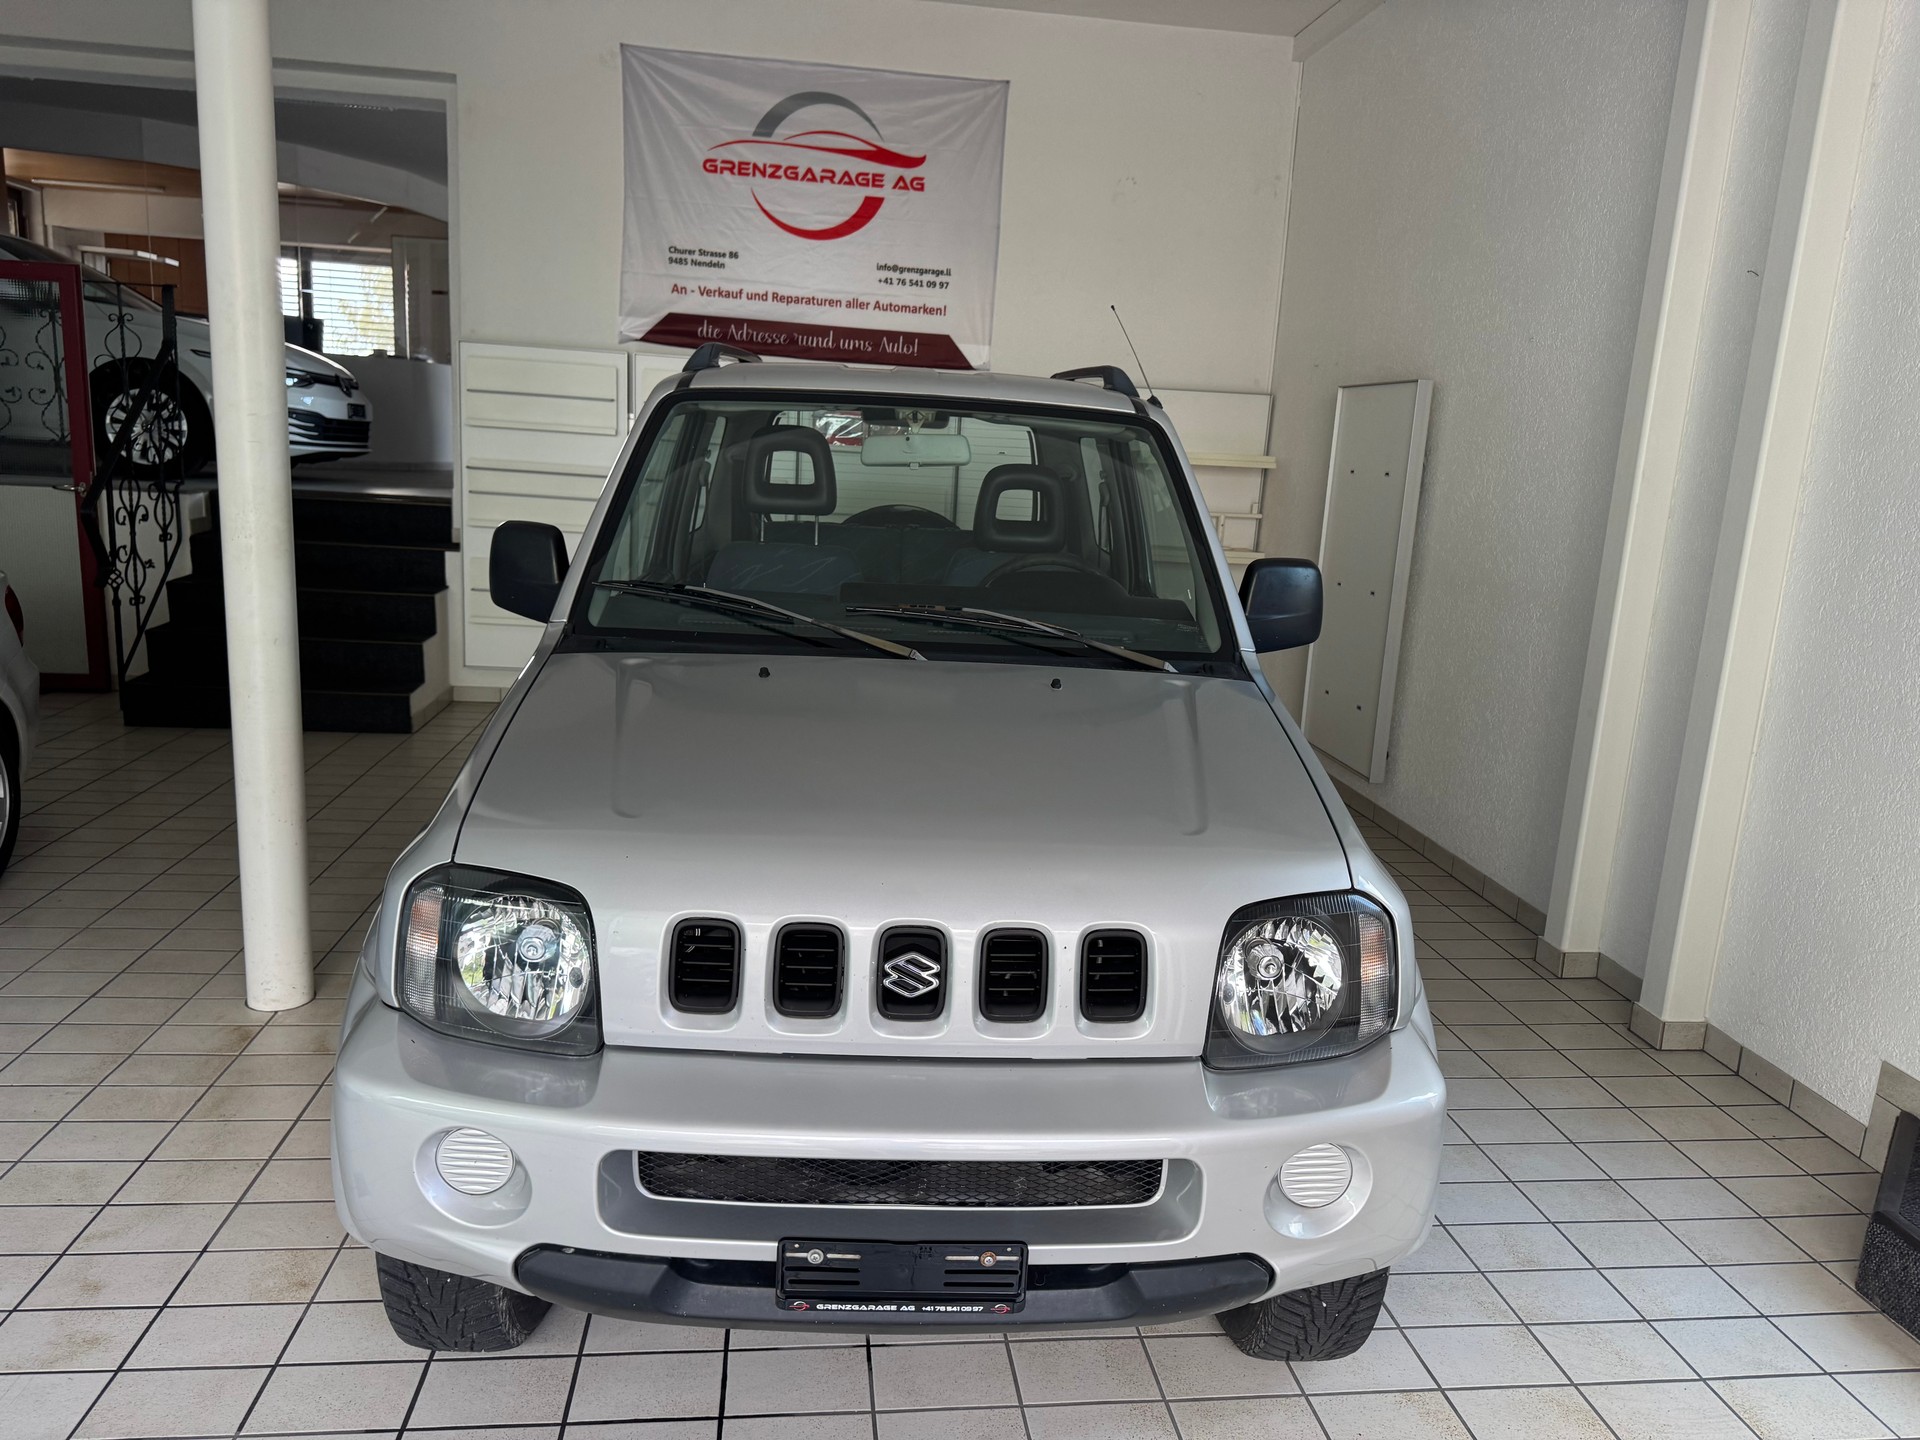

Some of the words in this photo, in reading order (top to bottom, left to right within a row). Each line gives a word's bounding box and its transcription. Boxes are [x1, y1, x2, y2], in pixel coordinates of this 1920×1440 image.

[702, 158, 885, 189] GRENZGARAGE
[891, 174, 925, 193] AG
[668, 246, 696, 257] Churer
[698, 248, 727, 259] Strasse
[728, 251, 739, 260] 86
[668, 257, 688, 266] 9485
[690, 258, 726, 270] Nendeln
[876, 262, 952, 278] info@grenzgarage.li
[878, 277, 894, 286] +41
[896, 278, 907, 287] 76
[908, 279, 924, 289] 541
[926, 280, 937, 289] 09
[938, 281, 950, 290] 97
[671, 283, 688, 296] An
[698, 285, 744, 301] Verkauf
[746, 290, 768, 303] und
[771, 291, 842, 308] Reparaturen
[845, 297, 870, 311] aller
[873, 300, 947, 317] Automarken!
[697, 319, 723, 339] die
[727, 322, 790, 345] Adresse
[793, 329, 837, 350] rund
[840, 336, 873, 352] ums
[816, 1303, 898, 1312] GRENZGARAGE
[899, 1304, 916, 1312] AG
